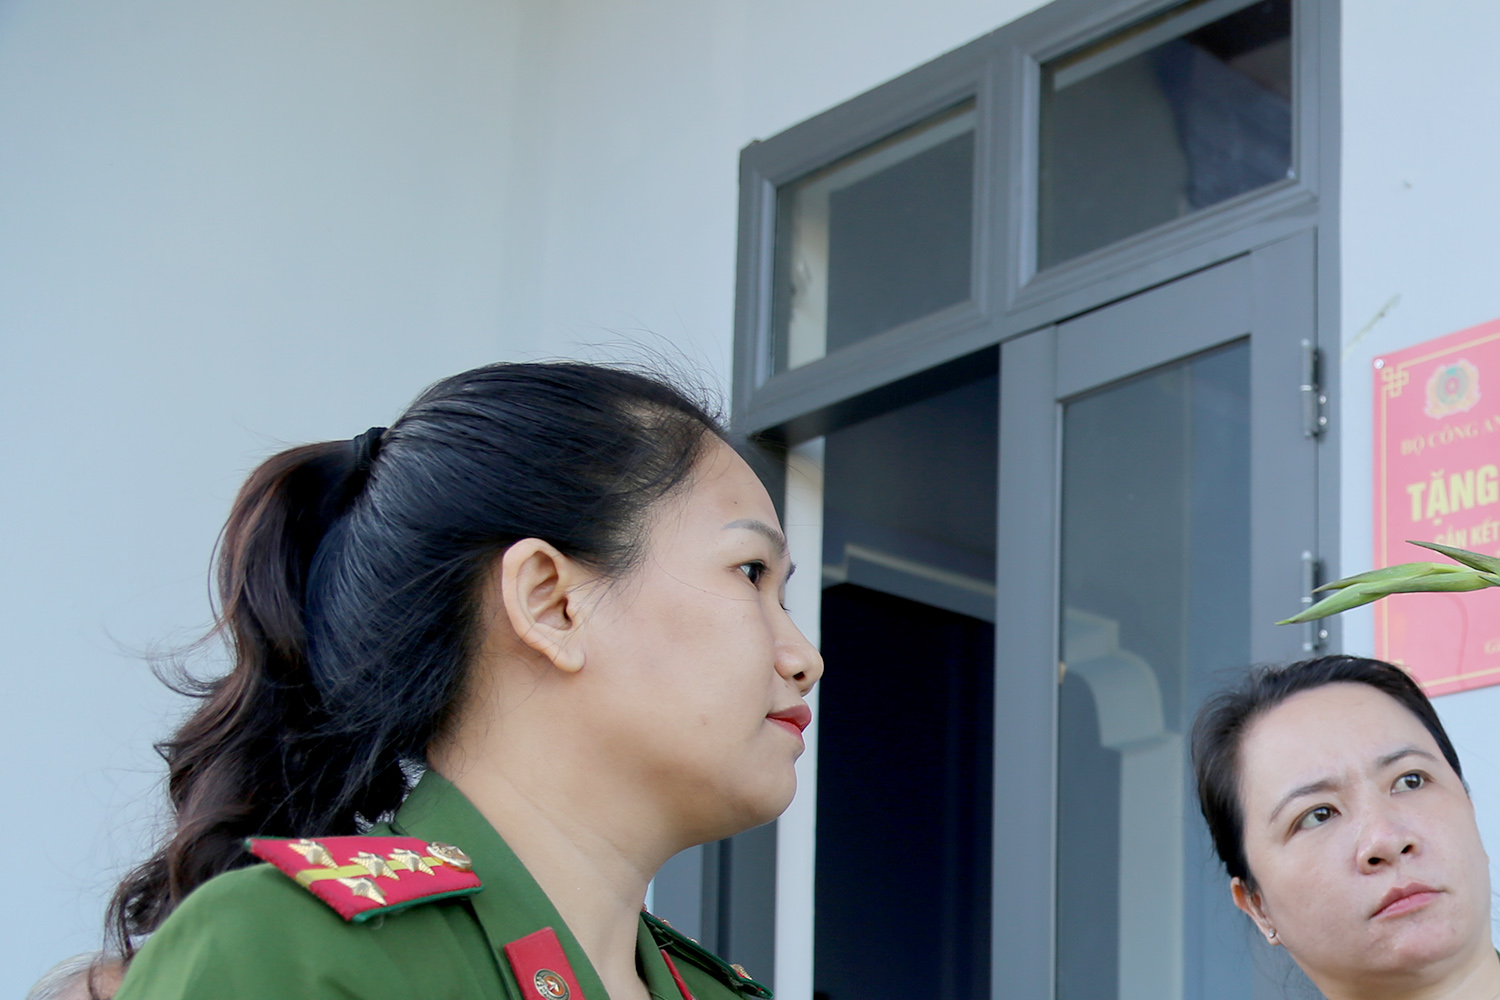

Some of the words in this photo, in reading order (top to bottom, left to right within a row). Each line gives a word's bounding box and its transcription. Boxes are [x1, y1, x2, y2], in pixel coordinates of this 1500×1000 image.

[1401, 434, 1425, 456] BỘ
[1427, 421, 1479, 448] CÔNG
[1405, 463, 1500, 526] TẶNG
[1470, 517, 1500, 547] KẾT
